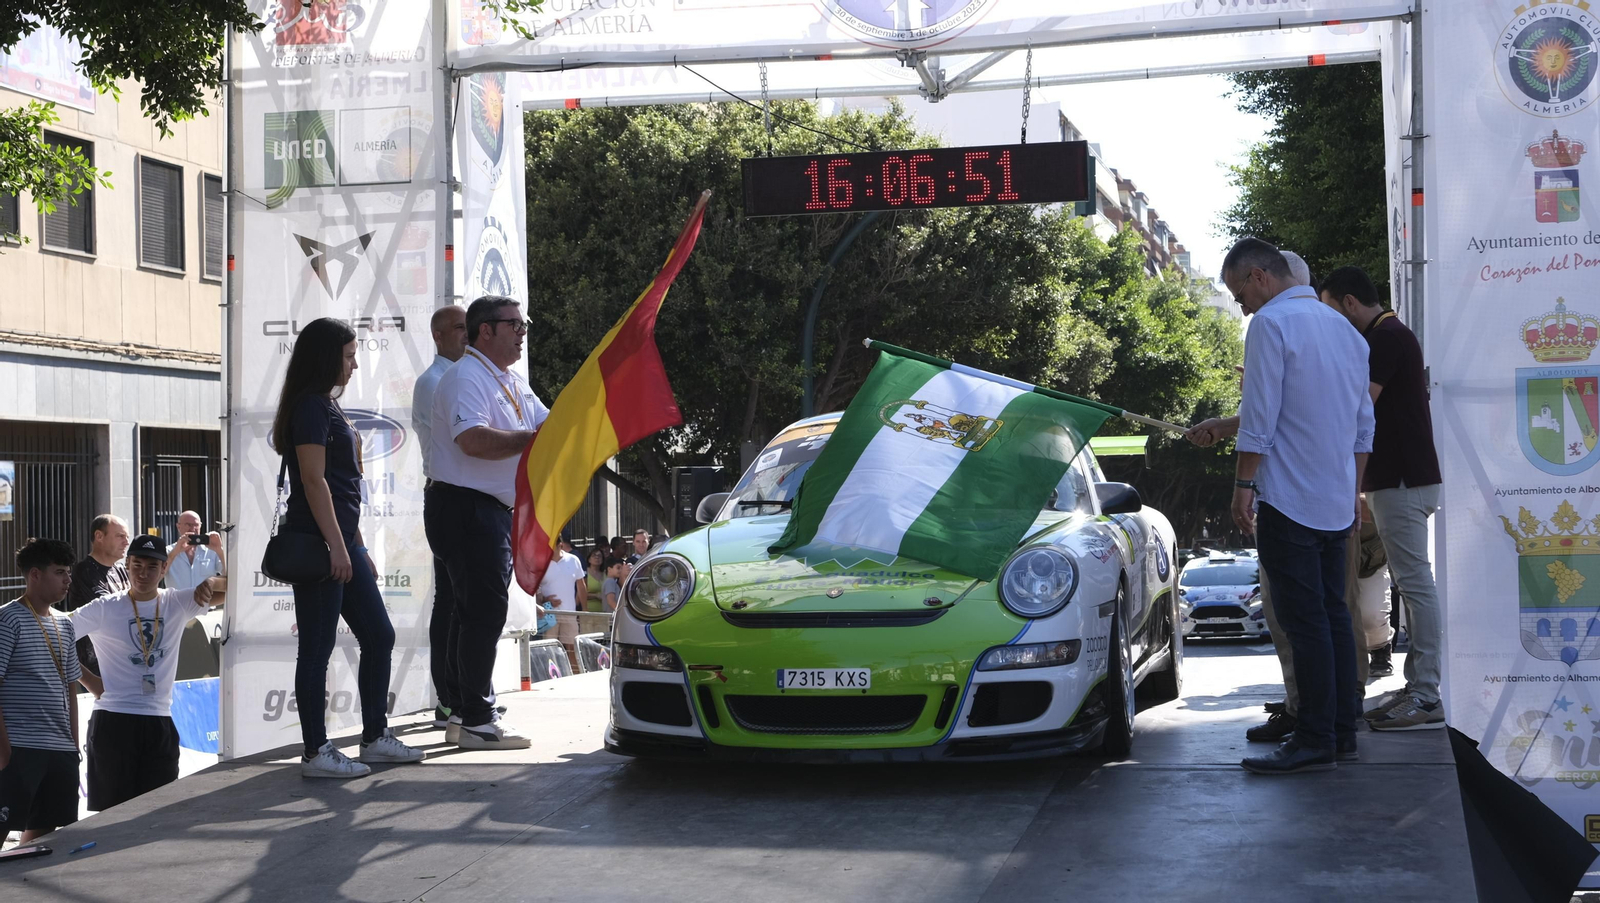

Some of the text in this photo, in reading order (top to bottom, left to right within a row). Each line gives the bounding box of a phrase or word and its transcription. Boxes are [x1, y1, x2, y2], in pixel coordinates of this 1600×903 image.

[551, 9, 655, 36] ALMERÍA
[845, 15, 857, 26] de
[857, 22, 906, 38] septiembre
[915, 29, 927, 38] de
[929, 16, 962, 34] octubre
[1501, 6, 1572, 50] AUTOMOVIL
[1523, 97, 1587, 114] ALMERIA
[353, 139, 397, 152] ALMERÍA
[803, 150, 1019, 209] 16:06:51
[1466, 232, 1578, 254] Ayuntamiento
[1480, 261, 1542, 283] Corazón
[1546, 254, 1570, 272] del
[1494, 486, 1563, 498] Ayuntamiento
[1564, 485, 1577, 494] de
[787, 671, 826, 687] 7315
[835, 671, 868, 687] KXS
[1483, 673, 1552, 685] Ayuntamiento
[1553, 674, 1566, 683] de
[1556, 771, 1599, 781] CERCA
